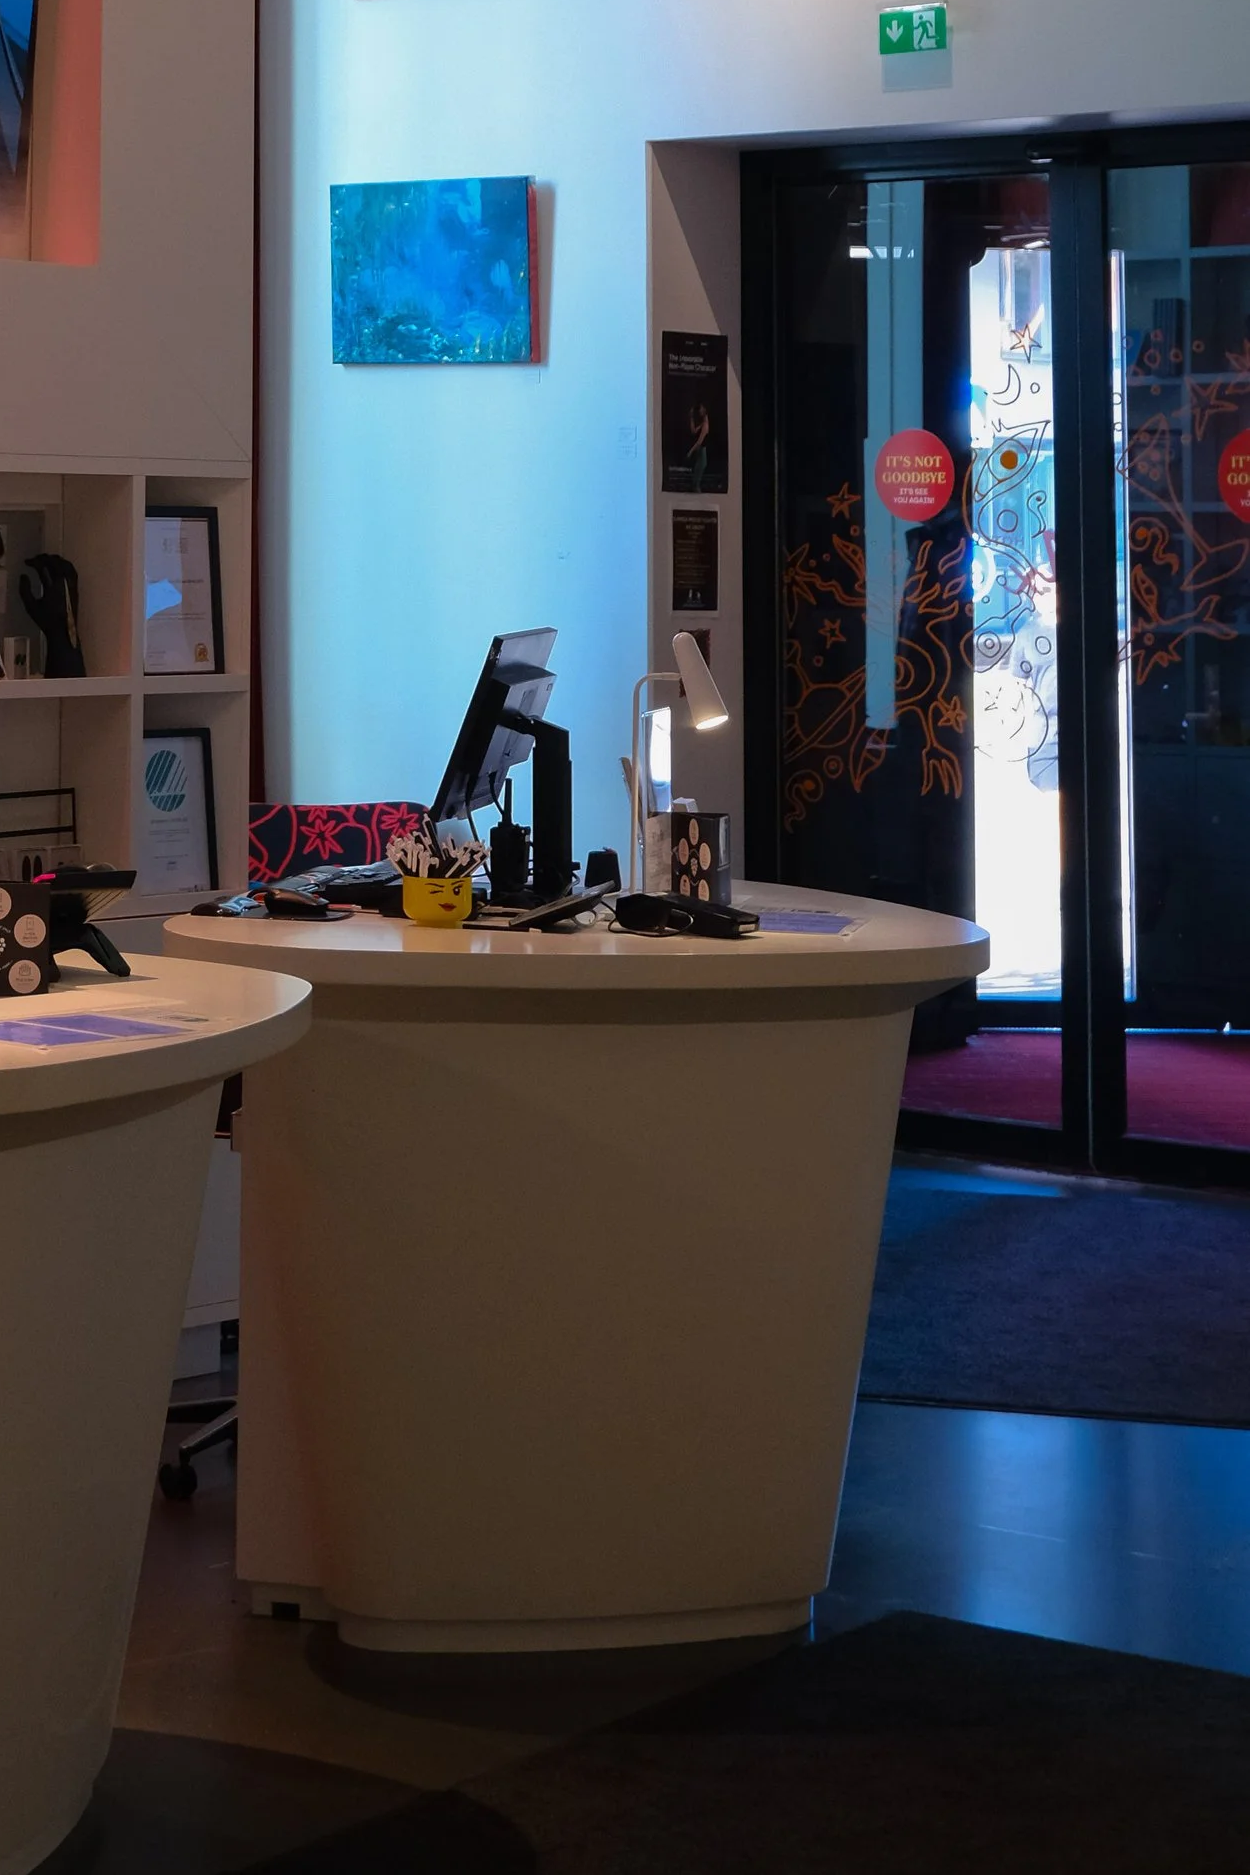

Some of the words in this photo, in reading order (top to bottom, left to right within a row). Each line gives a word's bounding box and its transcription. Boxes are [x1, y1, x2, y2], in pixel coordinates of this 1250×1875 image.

[885, 455, 911, 468] IT'S
[914, 455, 942, 468] NOT
[882, 471, 947, 484] GOODBYE
[893, 496, 908, 504] YOU
[909, 496, 935, 504] AGAIN!
